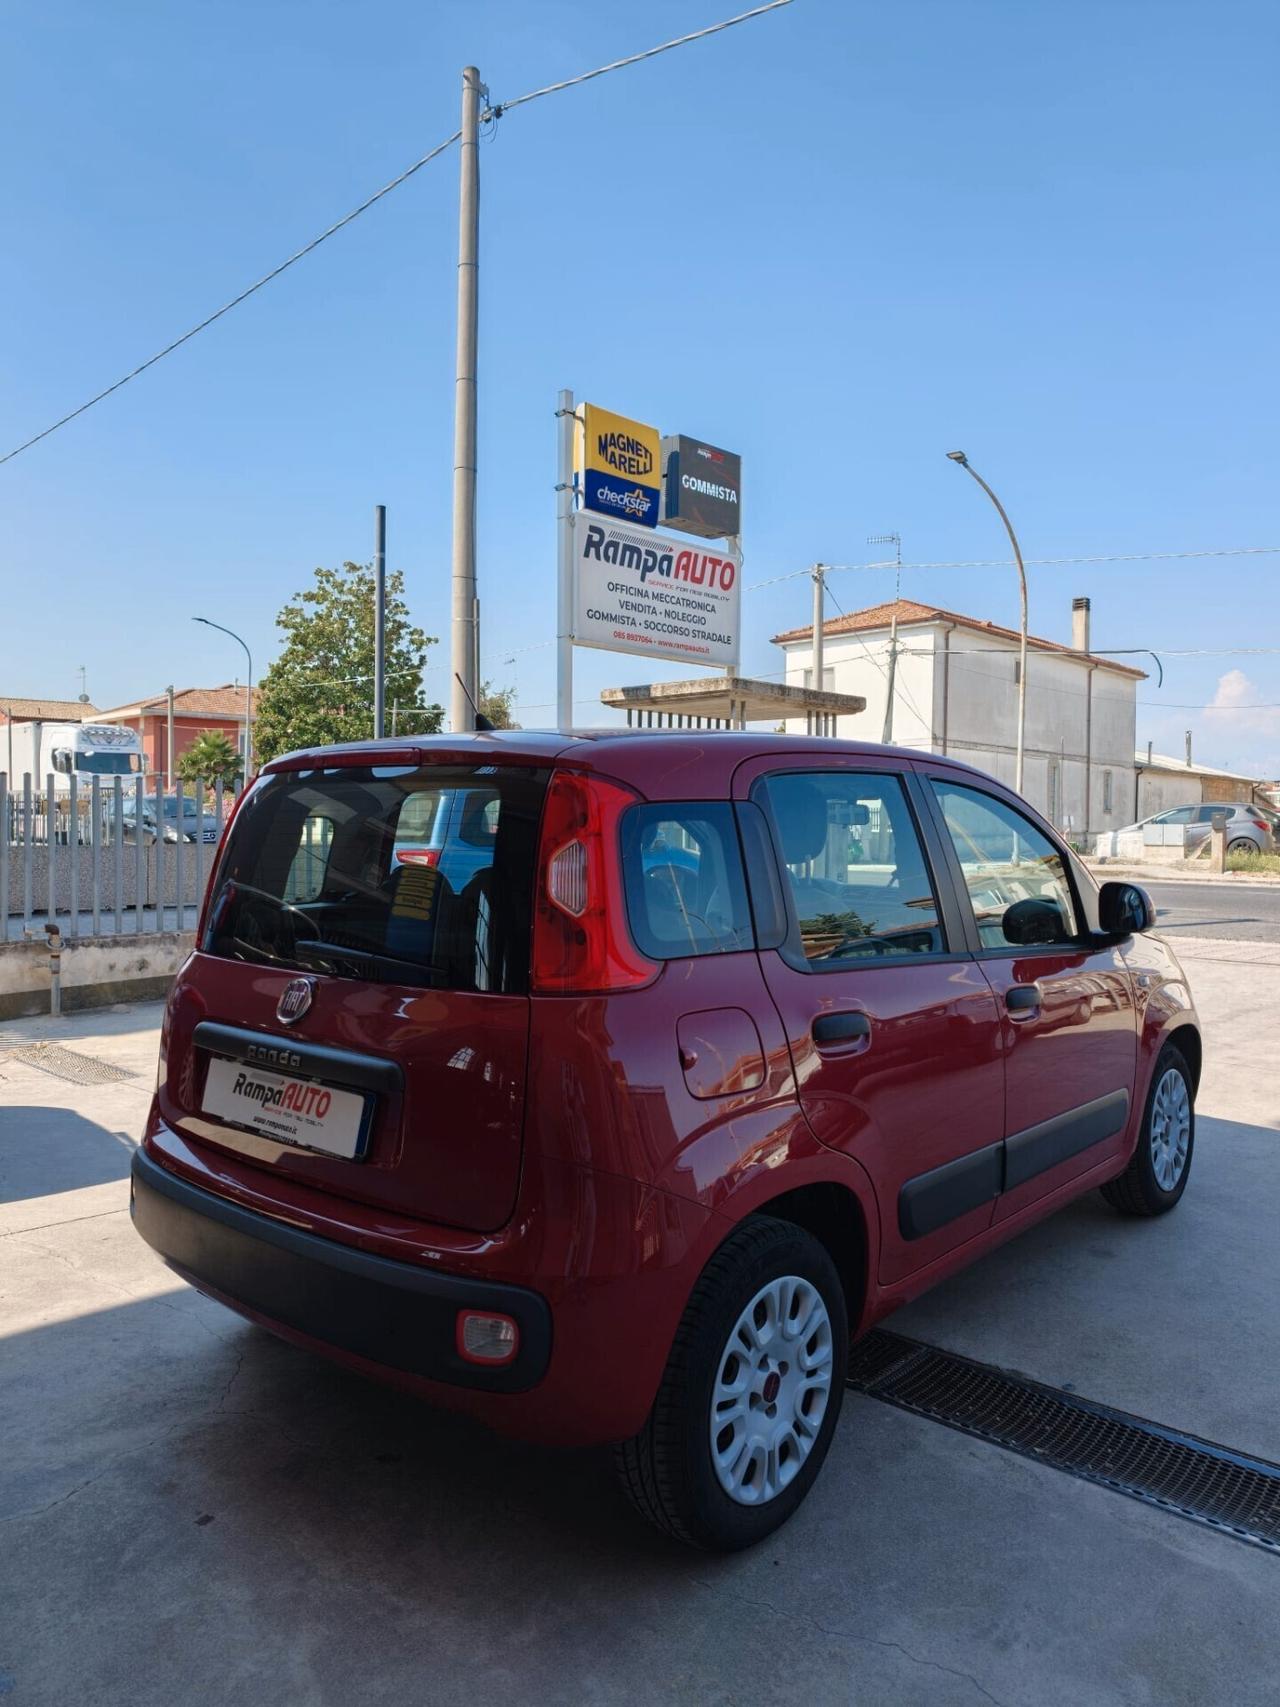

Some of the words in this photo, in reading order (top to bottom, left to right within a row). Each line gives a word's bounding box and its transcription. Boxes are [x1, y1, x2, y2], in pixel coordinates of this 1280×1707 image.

[597, 486, 652, 512] checkstar
[682, 474, 738, 504] GOMMISTA
[607, 581, 650, 600] OFFICINA
[651, 592, 717, 614] MECCATRONICA
[586, 608, 637, 627] GOMMISTA
[643, 619, 690, 637] SOCCORSO
[691, 629, 732, 645] STRADALE
[618, 599, 657, 616] VENDITA
[664, 609, 707, 626] NOLEGGIO
[282, 989, 307, 1011] FIAT
